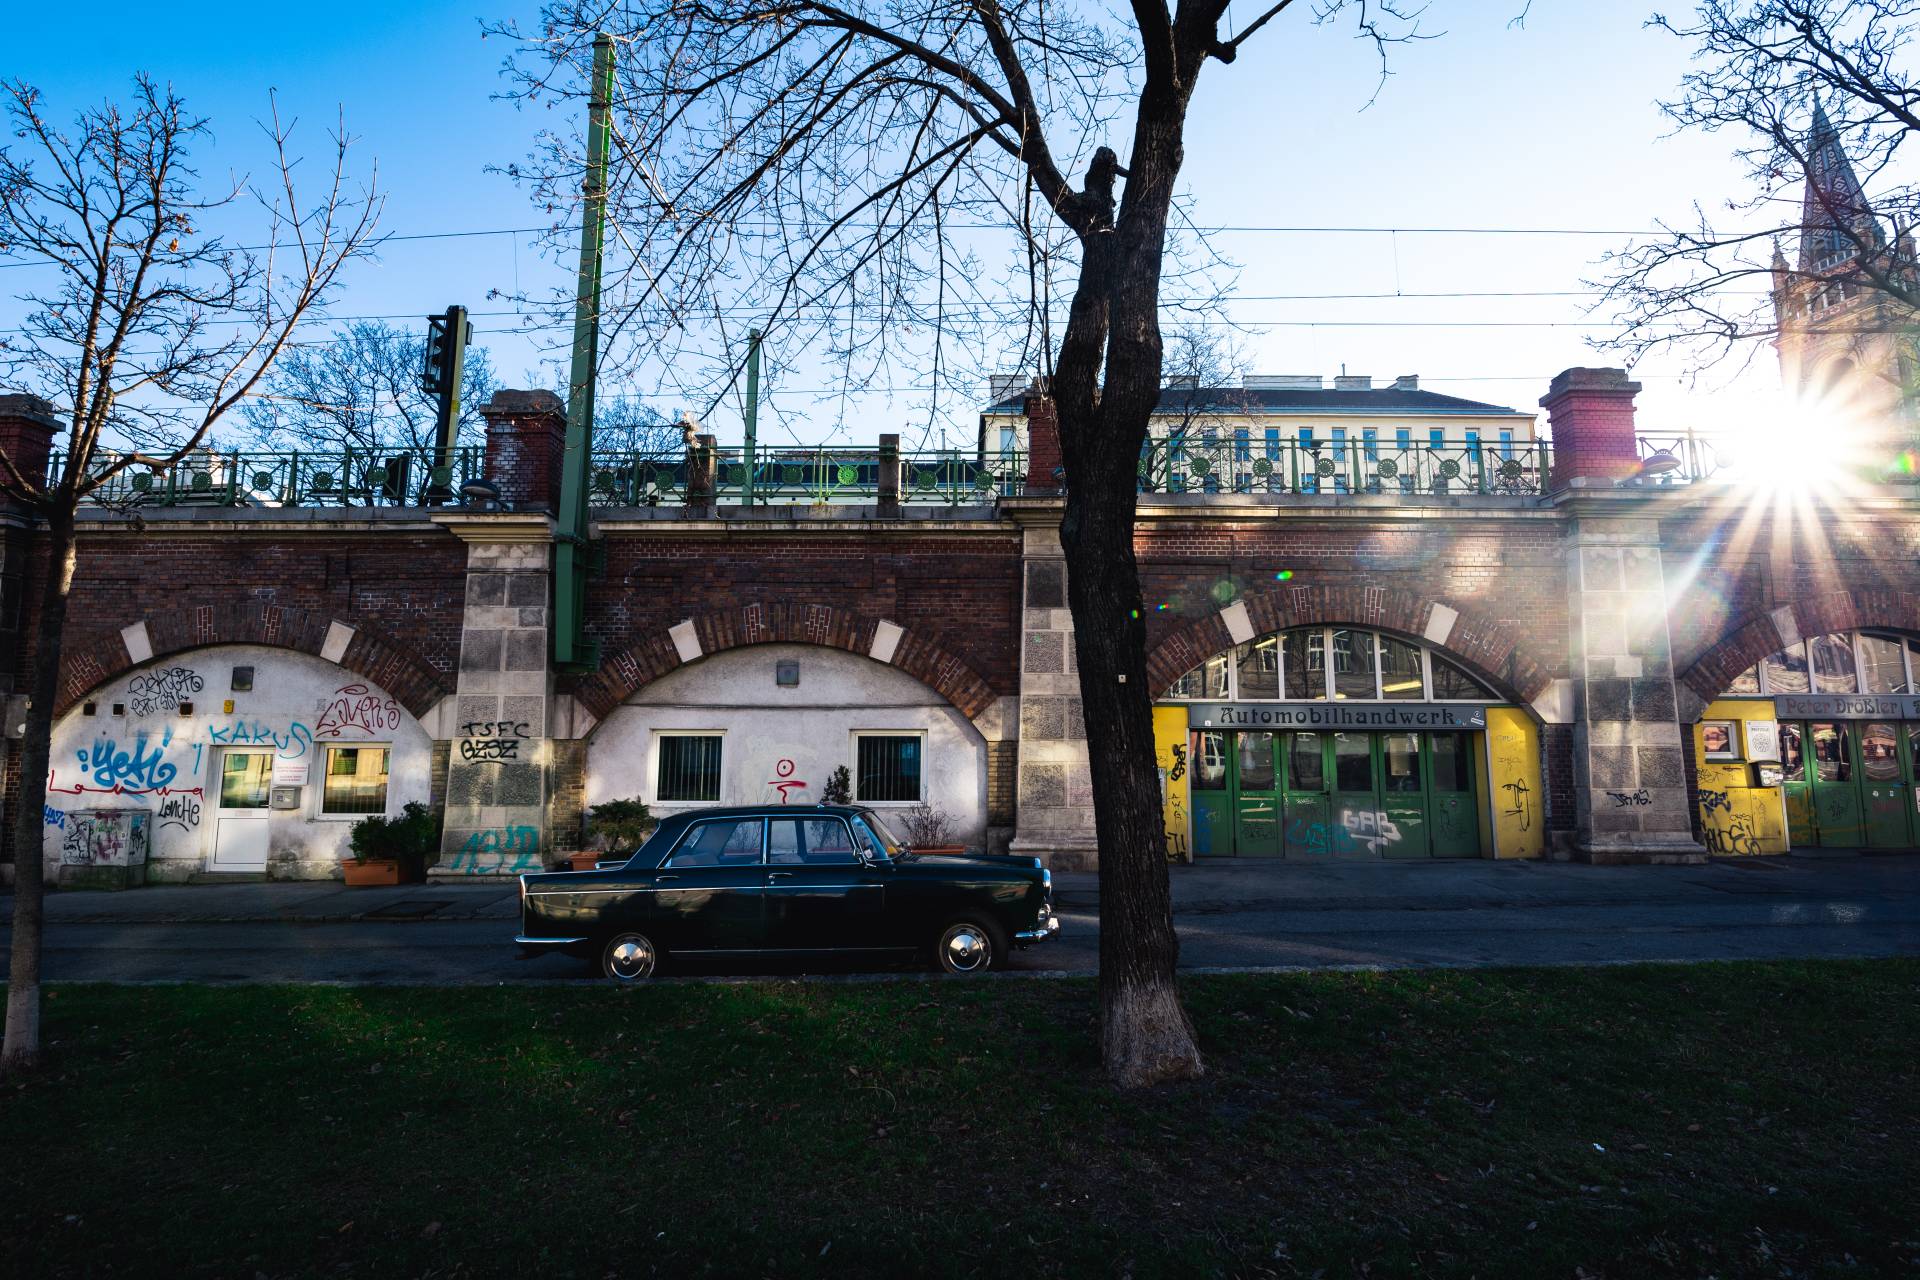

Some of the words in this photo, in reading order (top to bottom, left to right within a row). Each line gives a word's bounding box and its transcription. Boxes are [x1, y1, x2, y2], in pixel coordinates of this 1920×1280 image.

[1786, 698, 1831, 714] Peter
[1835, 698, 1897, 714] Drößler
[1220, 706, 1455, 725] Automobilhandwerk
[462, 721, 530, 739] TSFC
